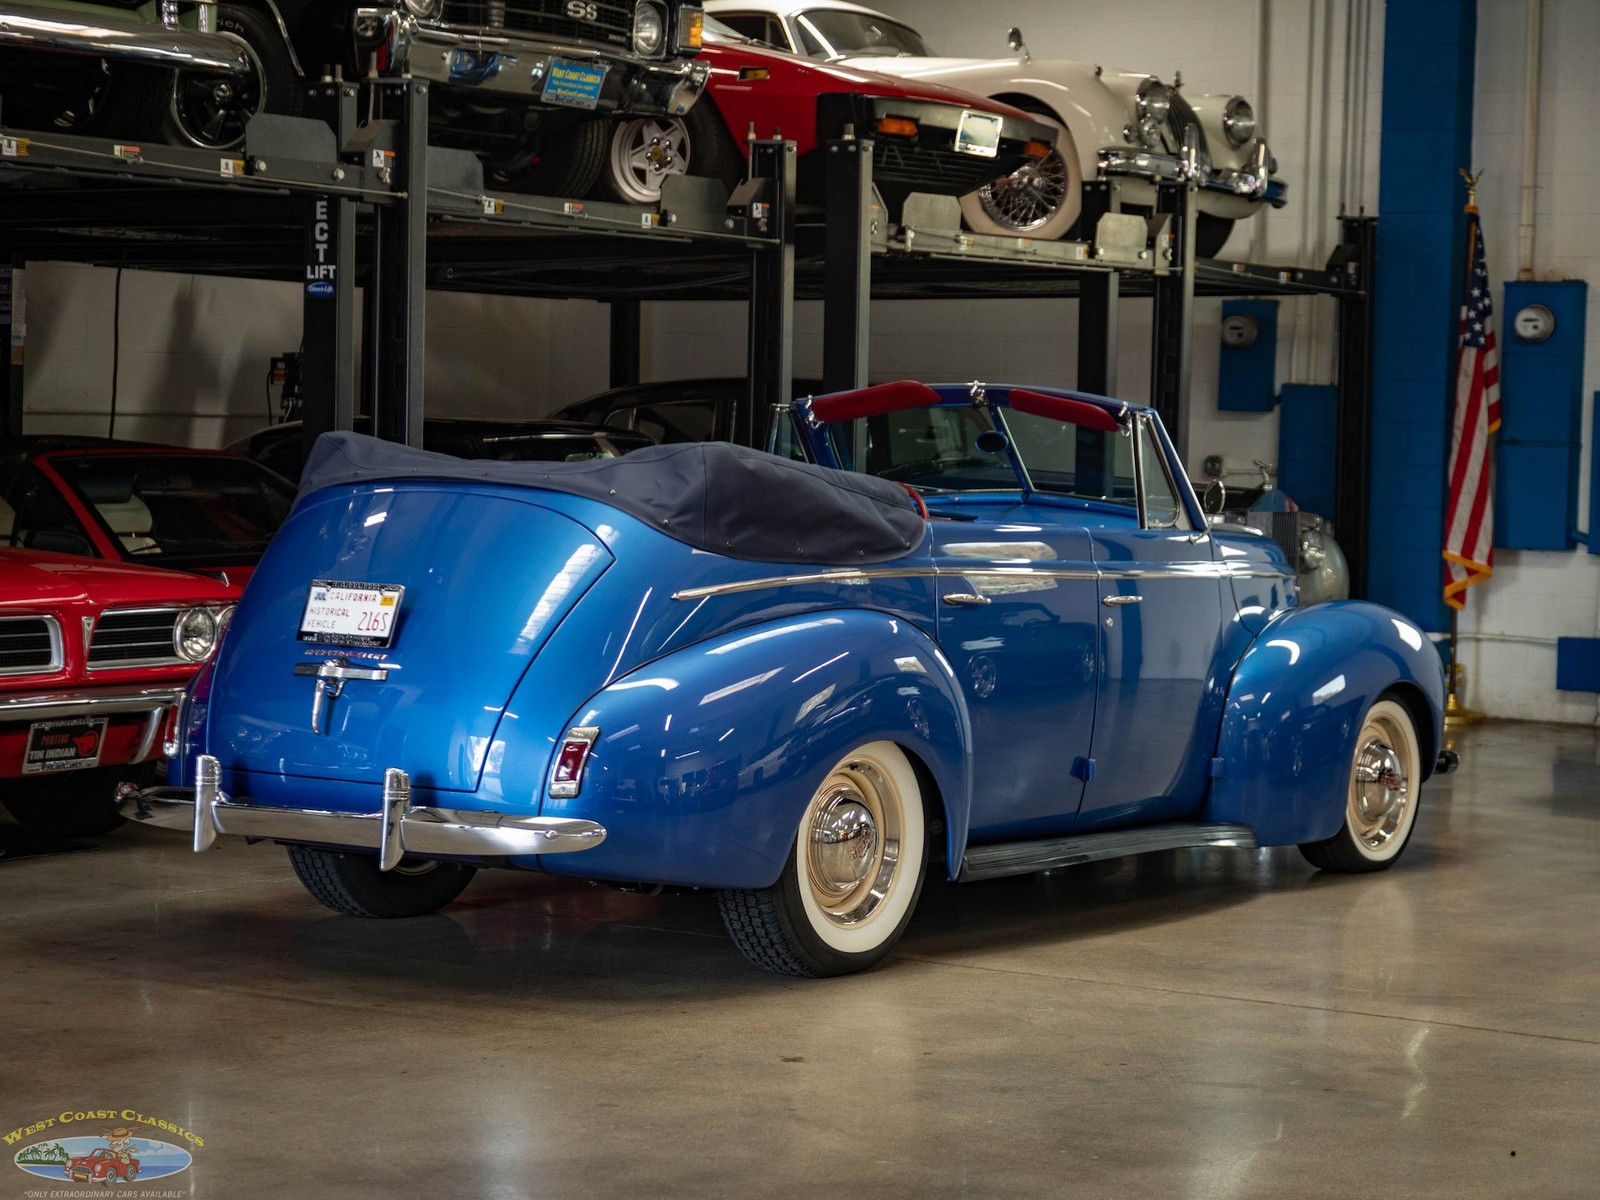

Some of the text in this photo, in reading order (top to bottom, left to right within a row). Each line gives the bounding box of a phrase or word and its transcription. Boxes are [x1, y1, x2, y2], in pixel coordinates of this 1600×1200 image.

[567, 1, 597, 20] SS
[306, 265, 336, 279] LIFT
[314, 592, 326, 601] JUL
[330, 592, 377, 602] CALIFORNIA
[310, 607, 350, 618] HISTORICAL
[307, 619, 337, 629] VEHICLE
[29, 747, 76, 761] TIN INDIAN
